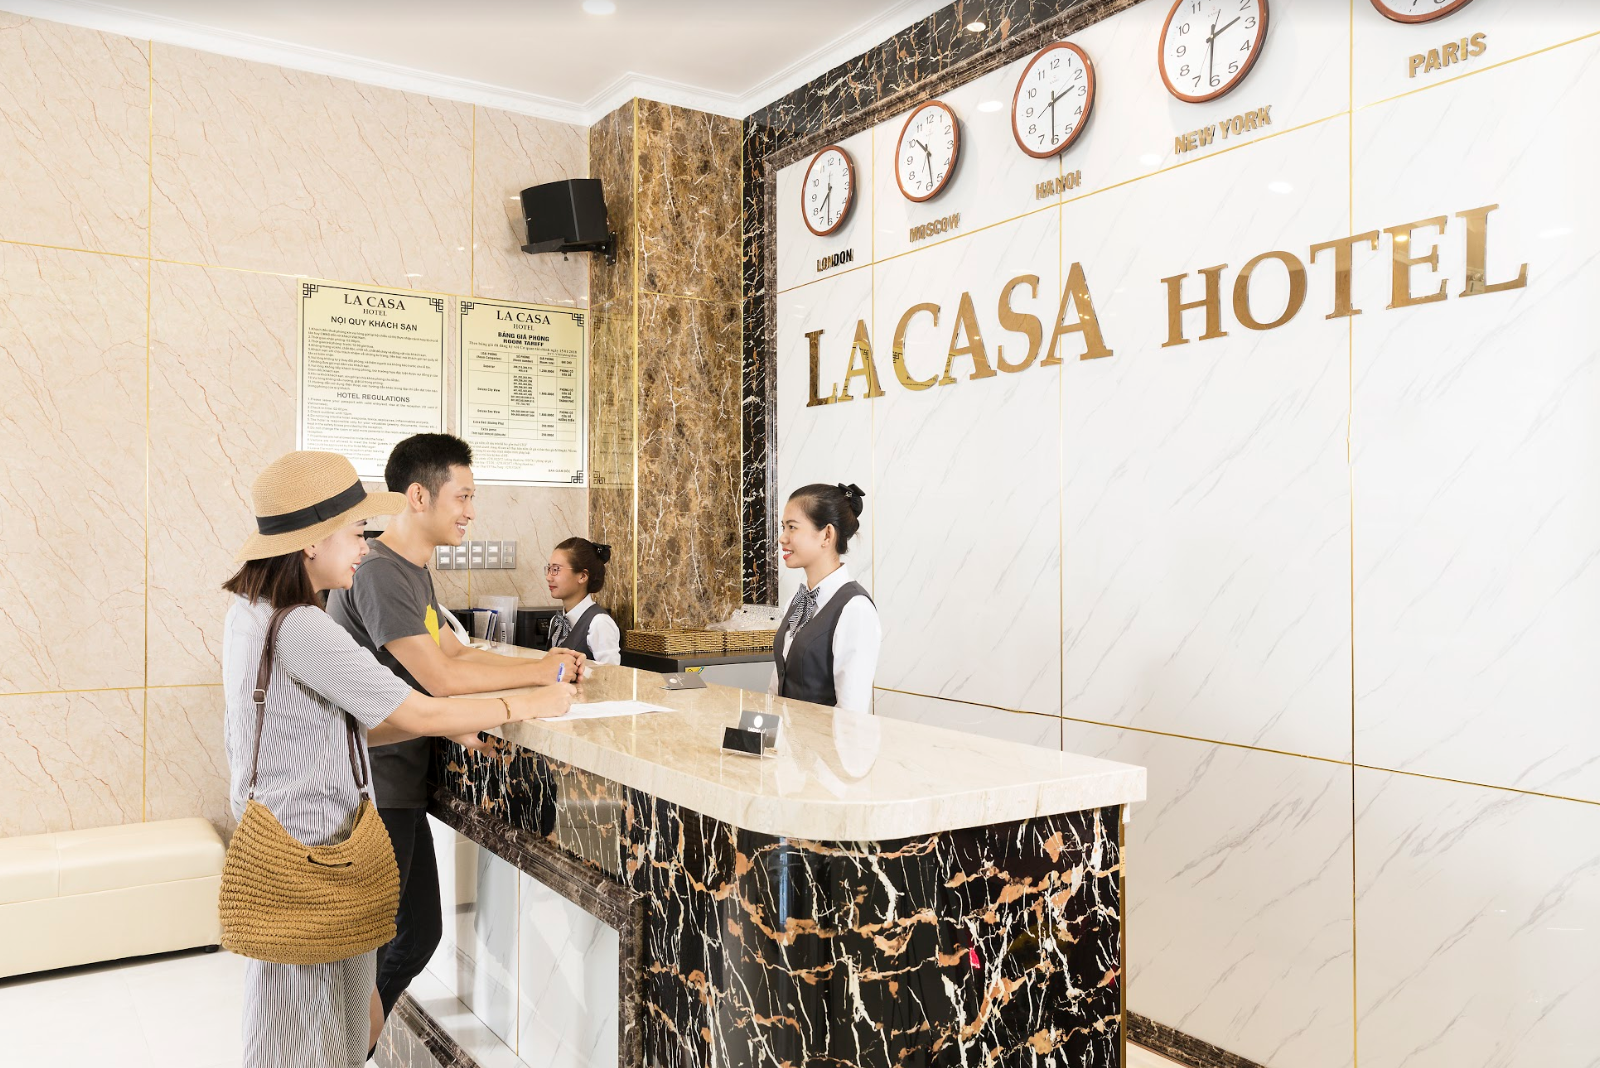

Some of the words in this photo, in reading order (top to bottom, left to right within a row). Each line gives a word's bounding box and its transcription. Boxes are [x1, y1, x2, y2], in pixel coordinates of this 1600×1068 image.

[1191, 2, 1201, 14] 11
[1244, 16, 1257, 29] 3
[1178, 22, 1190, 36] 10
[1176, 45, 1187, 58] 9
[1239, 39, 1251, 52] 4
[1408, 32, 1487, 78] PARIS
[1050, 58, 1060, 70] 12
[1067, 57, 1071, 67] 1
[1227, 60, 1239, 74] 5
[1037, 69, 1046, 81] 11
[1074, 68, 1083, 80] 2
[1179, 64, 1190, 77] 8
[1192, 75, 1201, 88] 7
[1209, 74, 1221, 87] 6
[1027, 87, 1037, 99] 10
[1077, 85, 1087, 97] 3
[1025, 107, 1034, 118] 9
[1073, 105, 1082, 116] 4
[925, 114, 935, 125] 12
[939, 114, 943, 123] 1
[916, 123, 923, 133] 11
[944, 124, 952, 135] 2
[1028, 123, 1037, 135] 8
[1064, 123, 1073, 134] 5
[1174, 124, 1216, 155] NEW
[1219, 104, 1272, 139] YORK
[908, 138, 917, 148] 10
[946, 140, 954, 150] 3
[1038, 134, 1045, 145] 7
[1051, 134, 1059, 146] 6
[906, 156, 914, 166] 9
[943, 157, 951, 167] 4
[908, 171, 916, 180] 8
[936, 172, 944, 182] 5
[916, 181, 922, 190] 7
[925, 181, 933, 191] 6
[1035, 169, 1082, 200] HANOI
[909, 212, 961, 243] MOSCOW
[816, 248, 854, 272] LONDON
[344, 293, 363, 306] LA
[366, 296, 406, 311] CASA
[804, 319, 886, 407] LA
[892, 261, 1114, 391] CASA
[1161, 203, 1528, 349] HOTEL
[363, 308, 387, 317] HOTEL
[496, 310, 513, 321] LA
[516, 312, 551, 326] CASA
[348, 317, 366, 326] QUY
[369, 319, 398, 329] KHÁCH
[400, 323, 418, 332] SẠN
[513, 323, 535, 332] HOTEL
[336, 392, 360, 400] HOTEL
[362, 393, 410, 403] REGULATIONS
